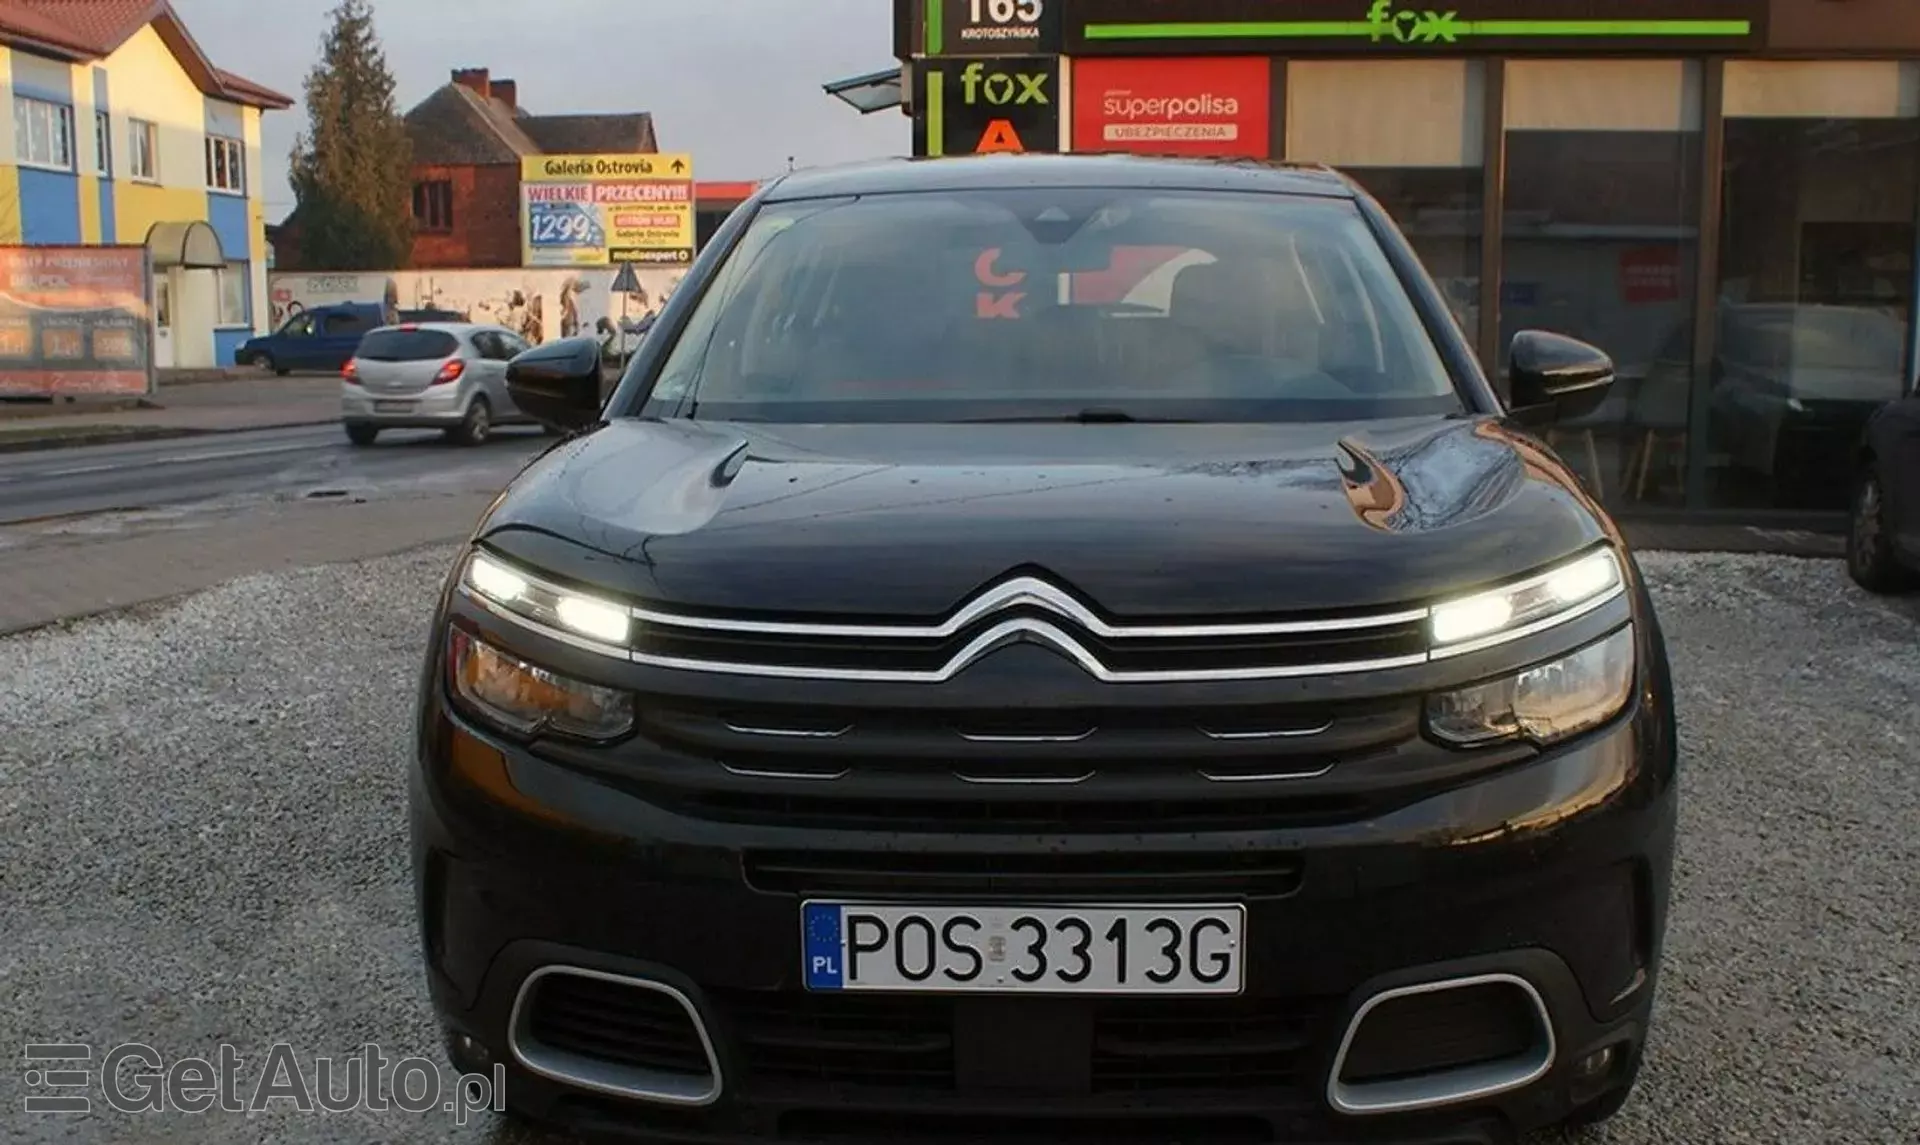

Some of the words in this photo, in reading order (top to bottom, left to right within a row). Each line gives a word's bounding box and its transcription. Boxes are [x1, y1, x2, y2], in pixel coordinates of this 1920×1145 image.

[970, 0, 1043, 23] 165
[1366, 0, 1458, 42] fox
[960, 63, 1049, 105] fox
[1103, 93, 1239, 120] superpolisa
[1114, 127, 1226, 138] UBEZPIECZENIA
[544, 160, 593, 175] Galeria
[596, 159, 653, 174] Ostrovia
[528, 186, 588, 201] WIELKIE
[846, 914, 983, 982] POS
[1010, 915, 1232, 984] 3313G
[812, 956, 838, 974] PL
